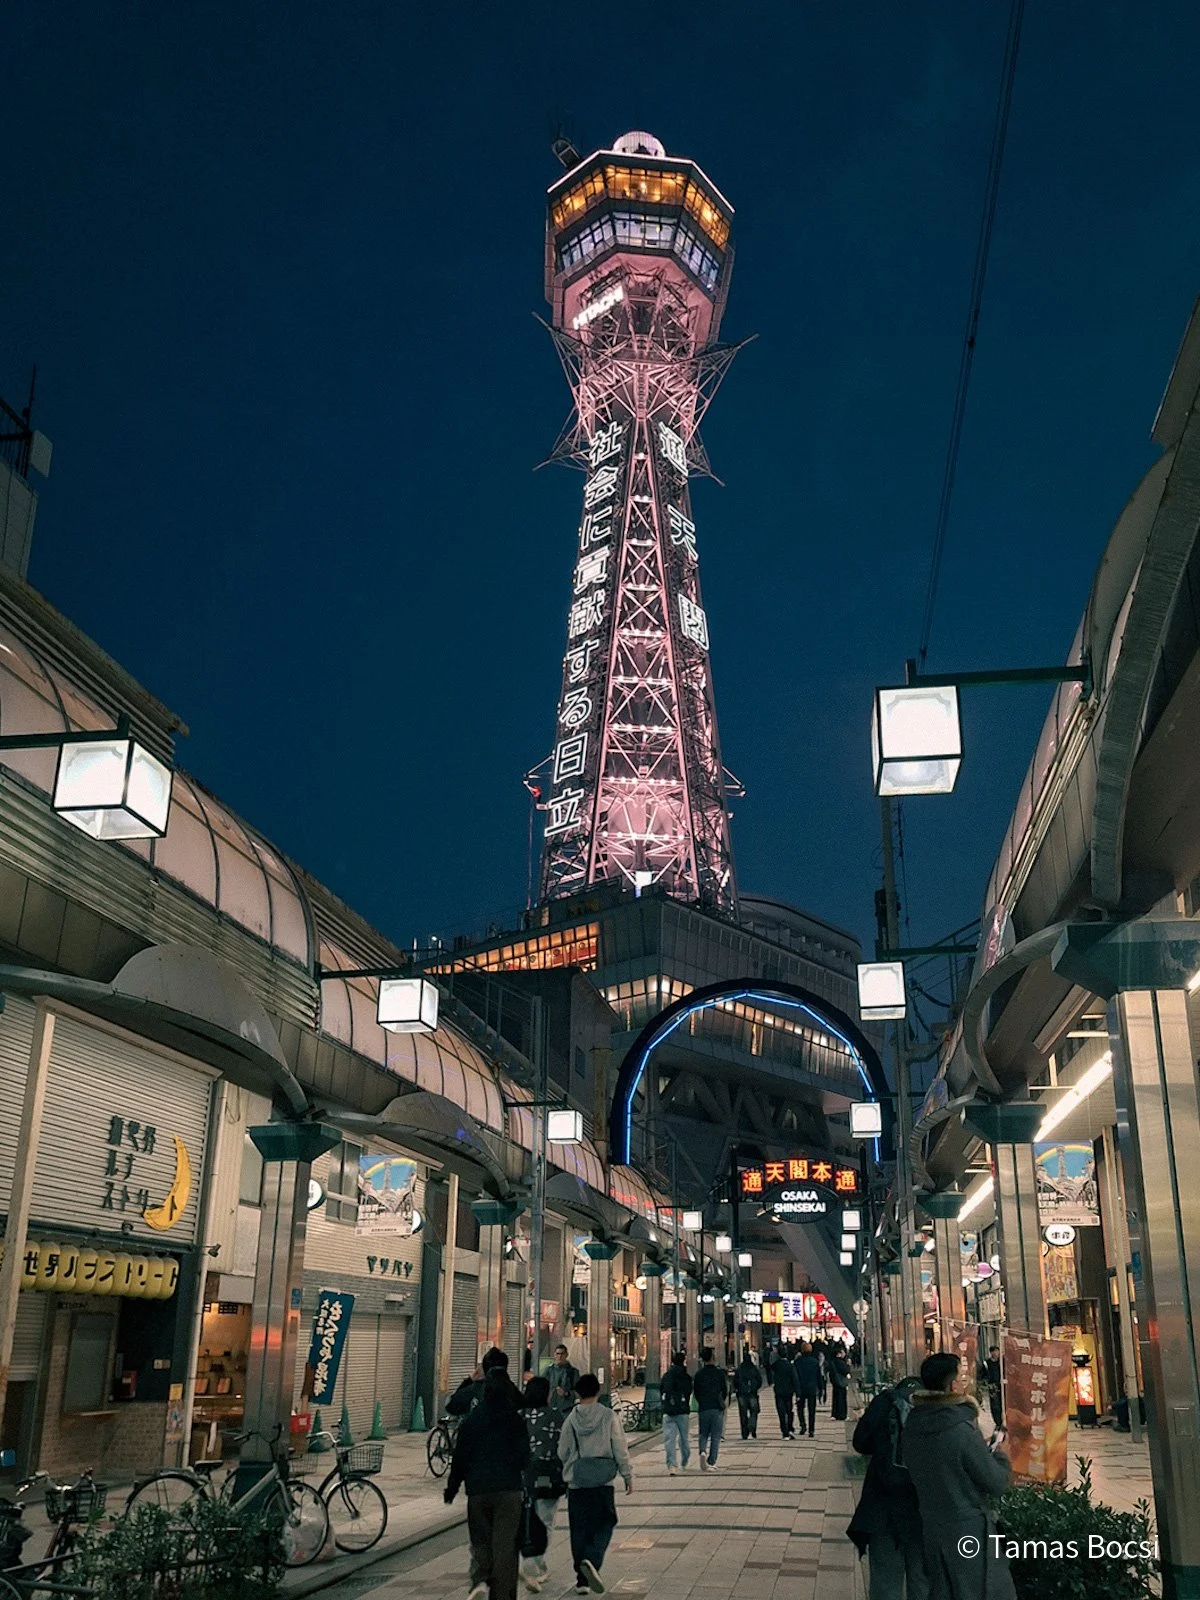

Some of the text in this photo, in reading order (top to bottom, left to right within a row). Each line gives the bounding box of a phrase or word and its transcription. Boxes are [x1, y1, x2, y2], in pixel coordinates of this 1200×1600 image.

[572, 284, 624, 330] HITACHI
[658, 421, 709, 651] 通天閣
[544, 421, 623, 837] 社会に貢献する日立
[104, 1149, 136, 1180] ルナ
[741, 1158, 857, 1193] 通天閣本通
[101, 1181, 178, 1222] ストリート
[773, 1202, 826, 1213] SHINSEKAI
[780, 1190, 818, 1201] OSAKA
[0, 1251, 178, 1288] 世界ルナストリート
